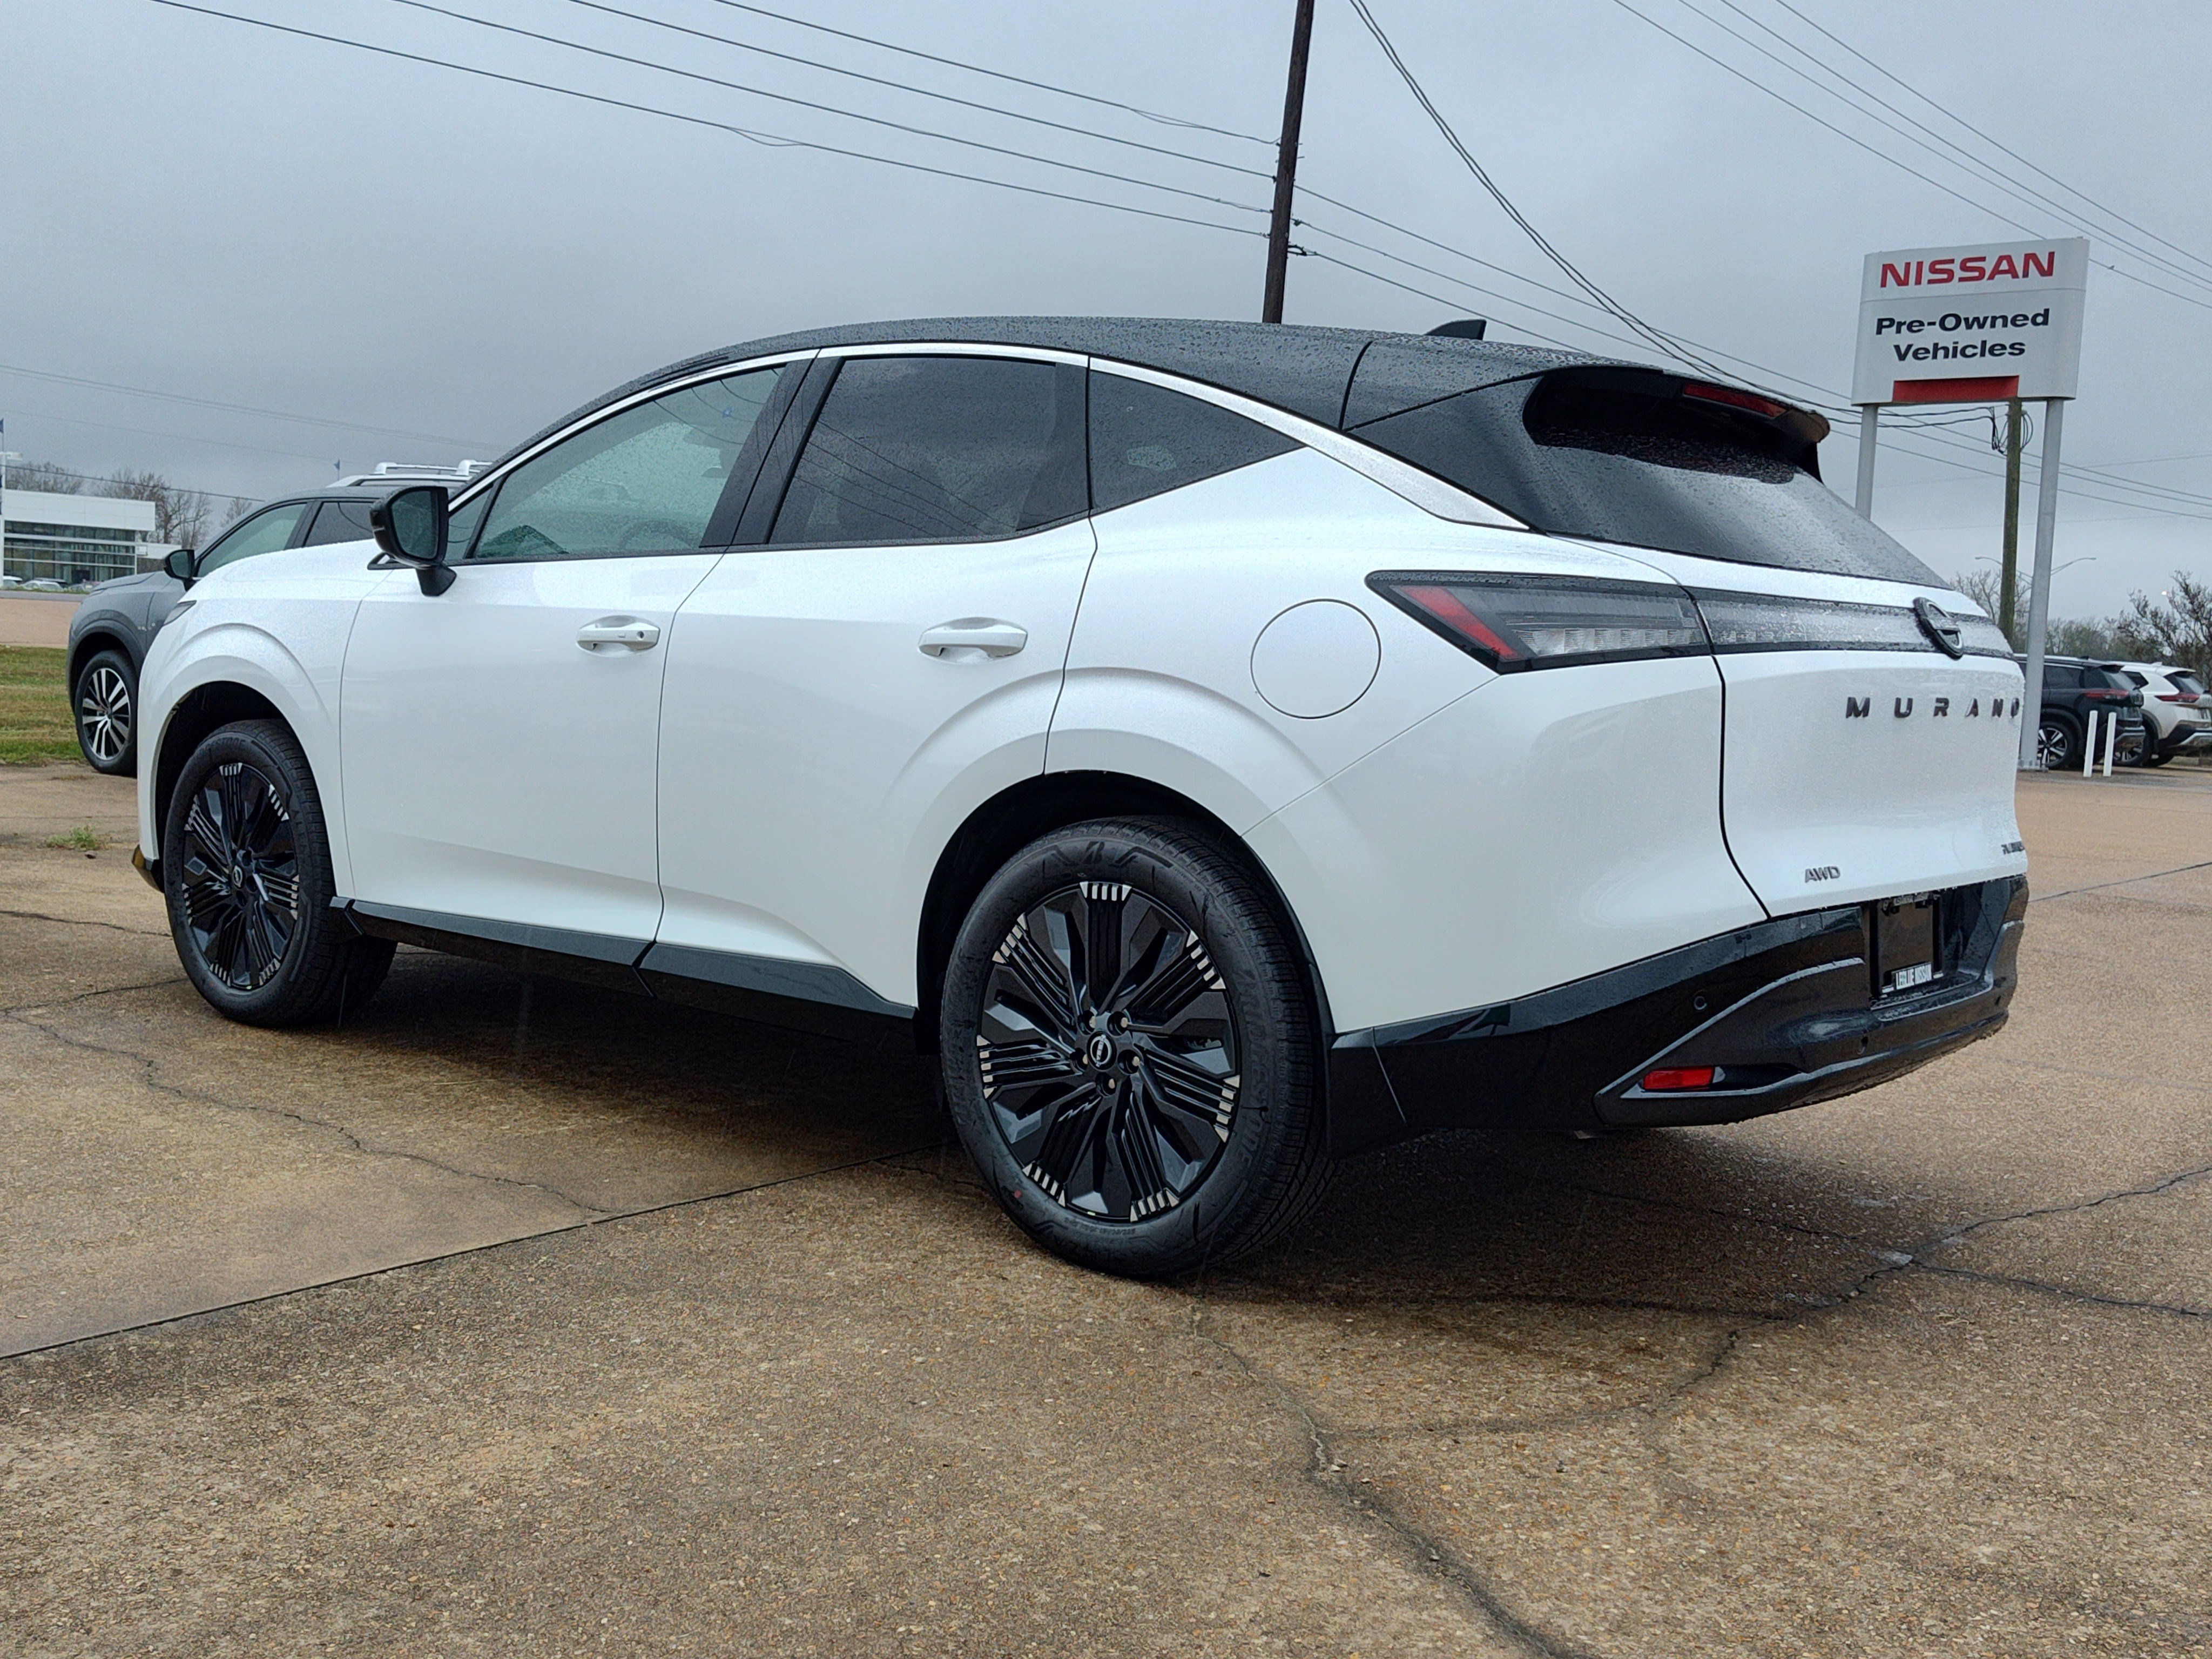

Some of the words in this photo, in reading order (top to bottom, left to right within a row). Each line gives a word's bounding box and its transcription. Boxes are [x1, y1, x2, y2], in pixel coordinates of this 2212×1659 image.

[1880, 252, 2055, 288] NISSAN
[1876, 308, 2050, 335] Pre-Owned
[1893, 340, 2026, 361] Vehicles
[1845, 696, 2020, 719] MURANO
[1804, 866, 1841, 883] AWD
